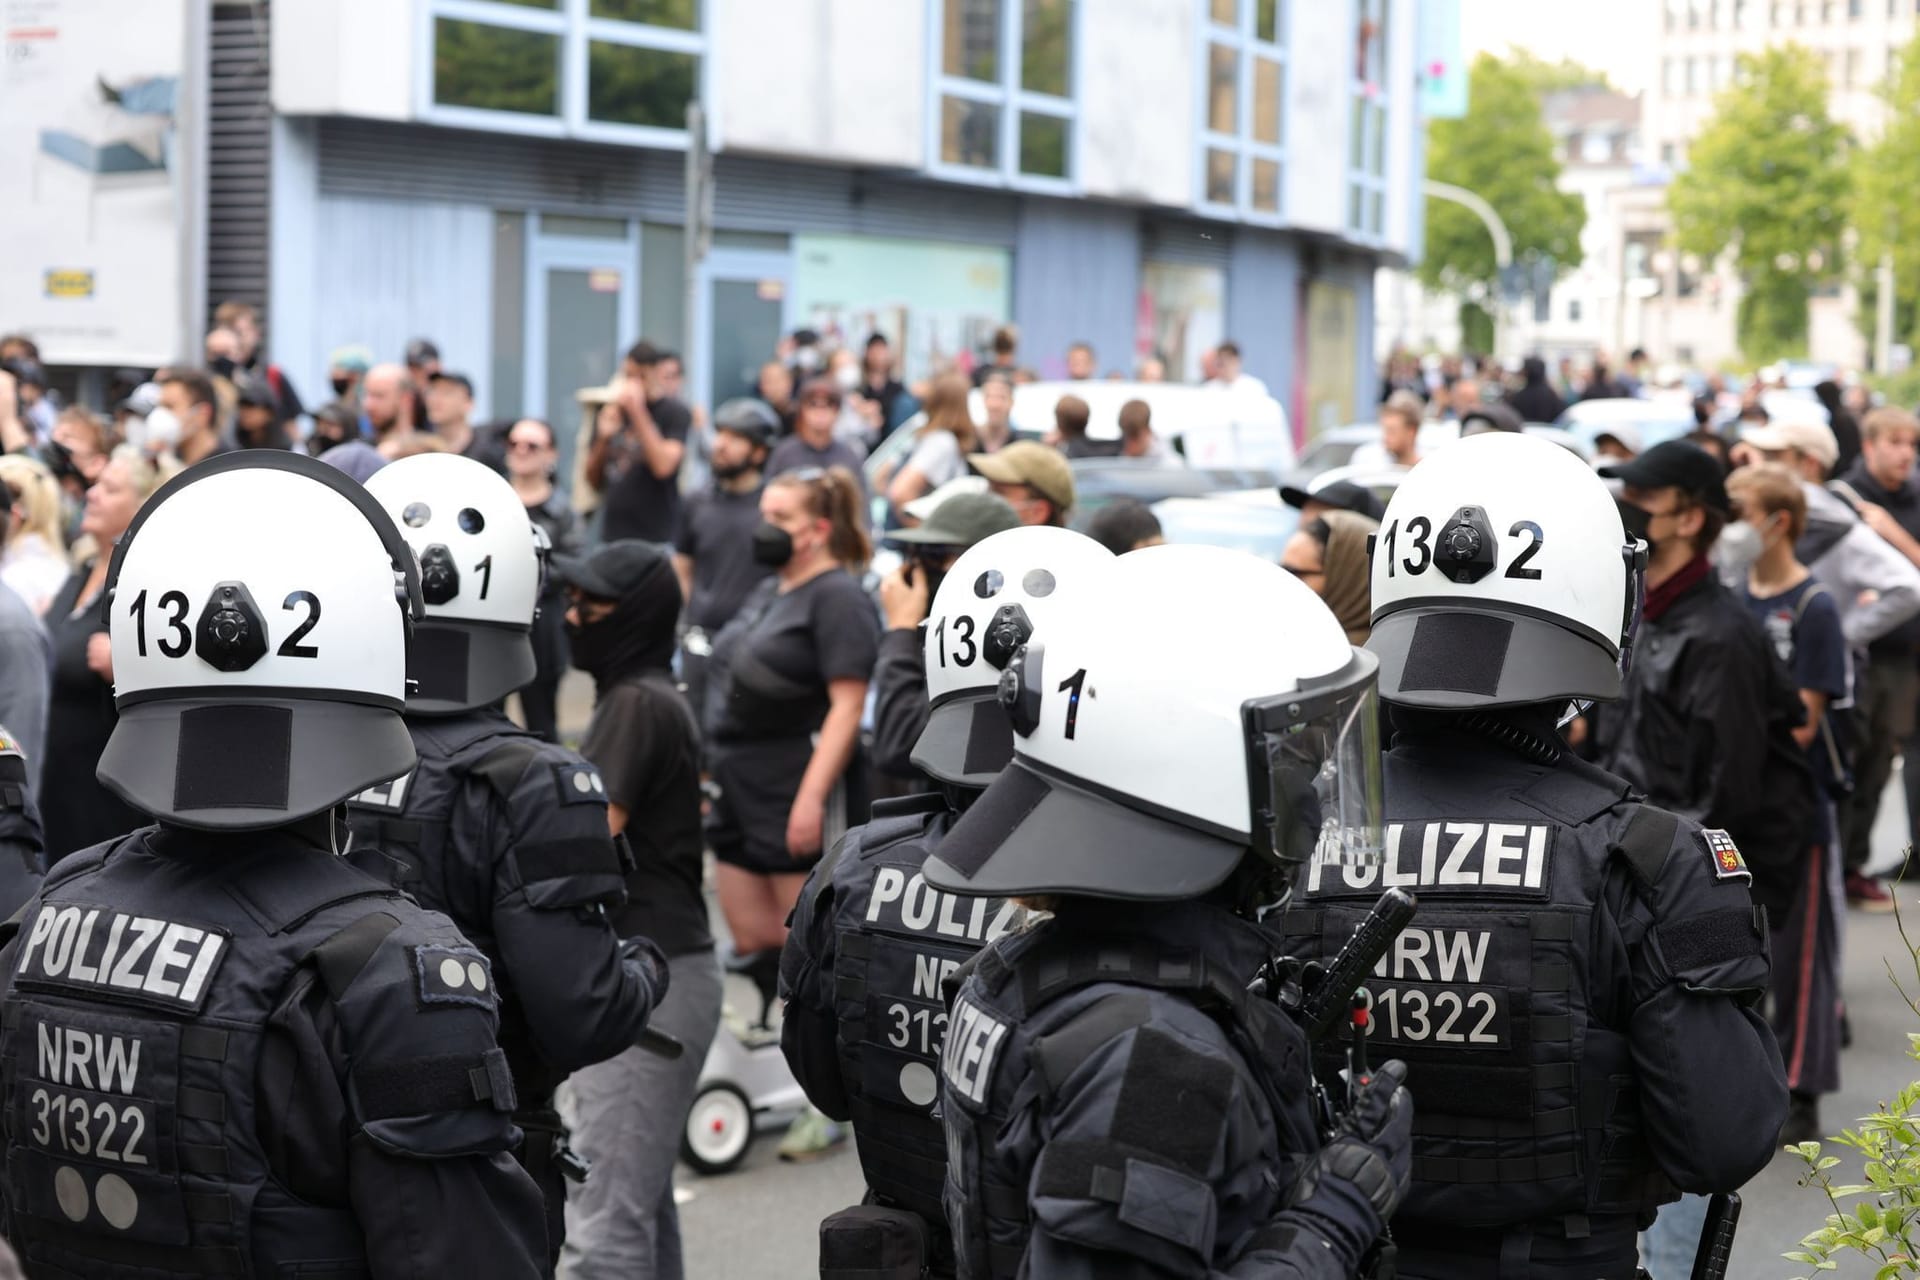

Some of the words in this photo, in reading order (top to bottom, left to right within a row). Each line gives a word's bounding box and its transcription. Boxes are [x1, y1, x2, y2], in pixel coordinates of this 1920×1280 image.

[474, 554, 492, 600] 1
[1384, 516, 1431, 578] 13
[1504, 520, 1544, 580] 2
[129, 589, 192, 659] 13
[277, 590, 321, 658] 2
[935, 615, 977, 668] 13
[1058, 668, 1087, 740] 1
[18, 906, 225, 1003] POLIZEI
[37, 1022, 141, 1096] NRW
[31, 1088, 149, 1166] 31322
